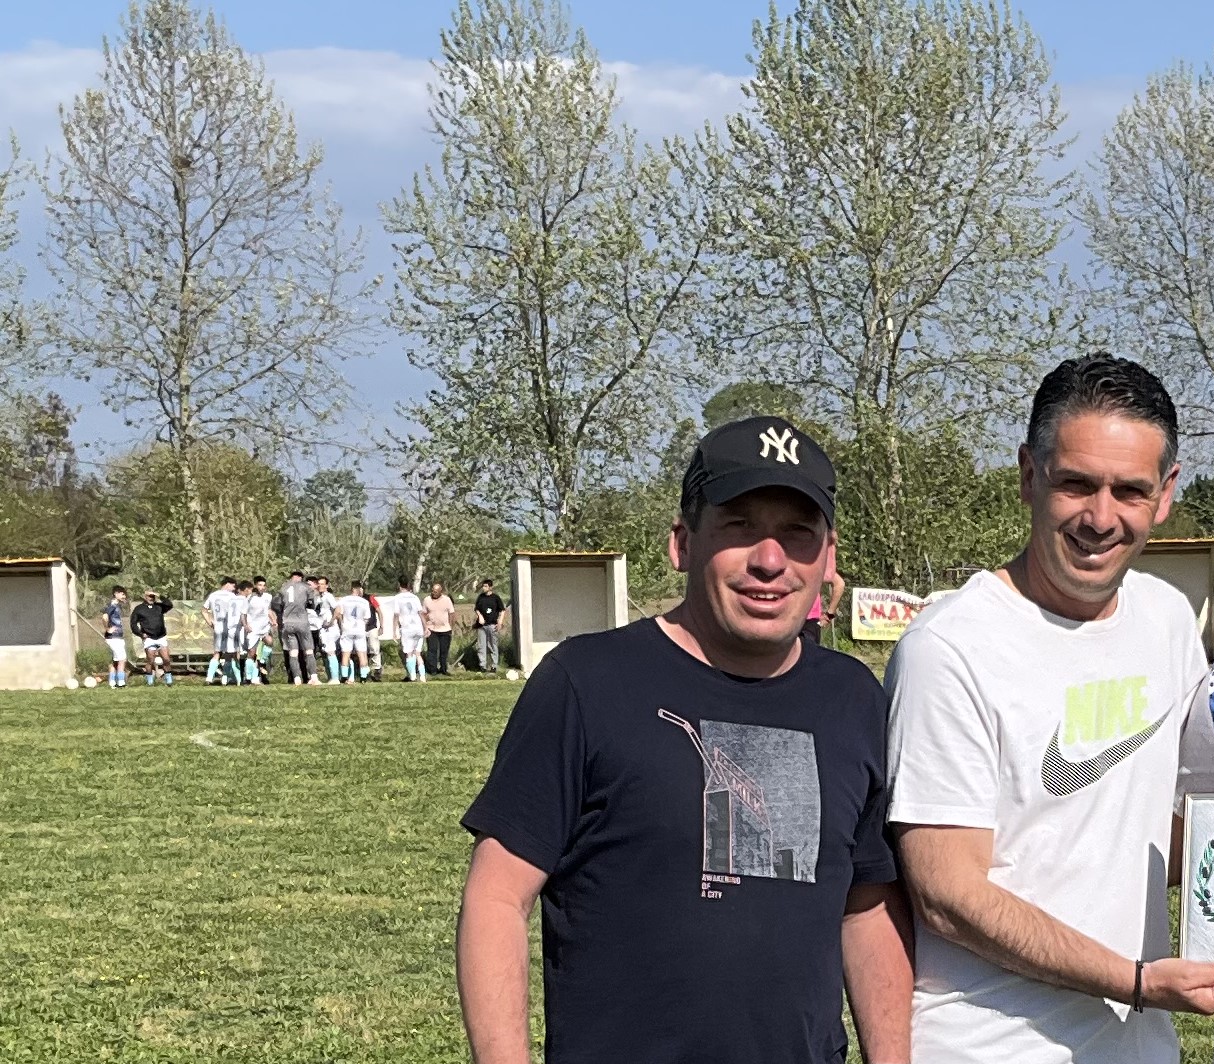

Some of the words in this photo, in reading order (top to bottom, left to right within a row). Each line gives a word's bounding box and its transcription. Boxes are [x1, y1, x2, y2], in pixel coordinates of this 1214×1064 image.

[759, 426, 799, 465] NY
[287, 585, 295, 602] 1
[350, 605, 358, 619] 4
[869, 602, 926, 621] MAX
[1063, 676, 1149, 745] NIKE
